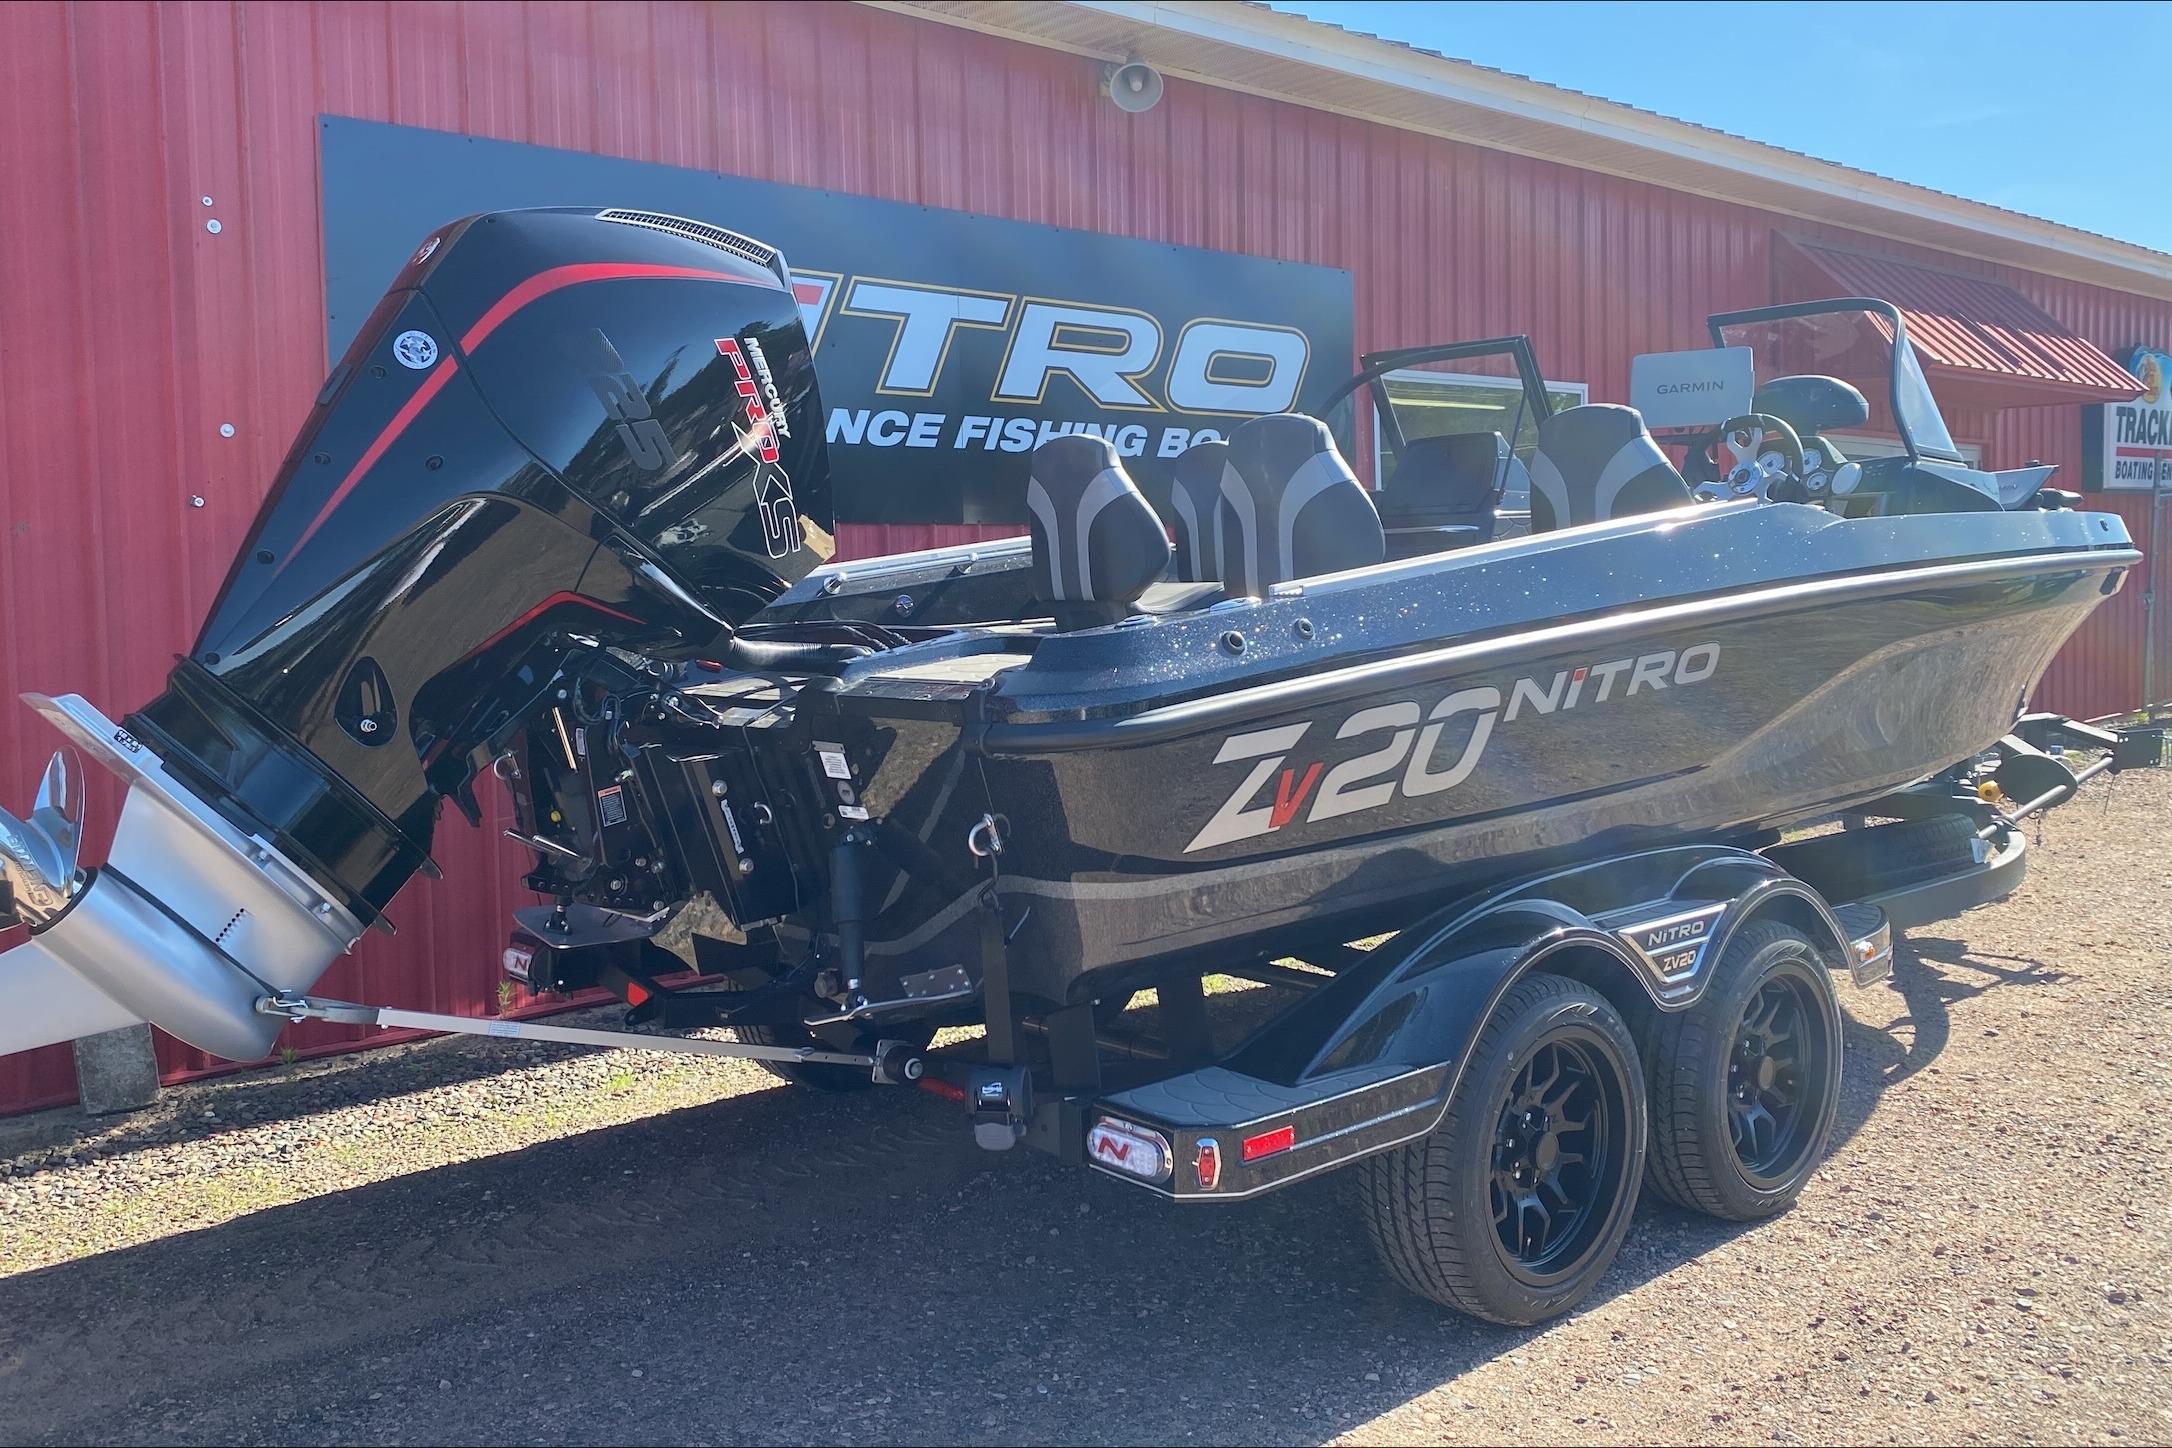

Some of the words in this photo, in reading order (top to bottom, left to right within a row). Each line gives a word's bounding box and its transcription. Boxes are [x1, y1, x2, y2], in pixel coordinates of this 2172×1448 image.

[714, 337, 780, 464] PRO
[744, 336, 791, 439] MERCURY
[1656, 380, 1724, 395] GARMIN
[730, 420, 801, 560] XS
[2115, 460, 2153, 480] BOATING
[1662, 949, 1697, 972] ZV20
